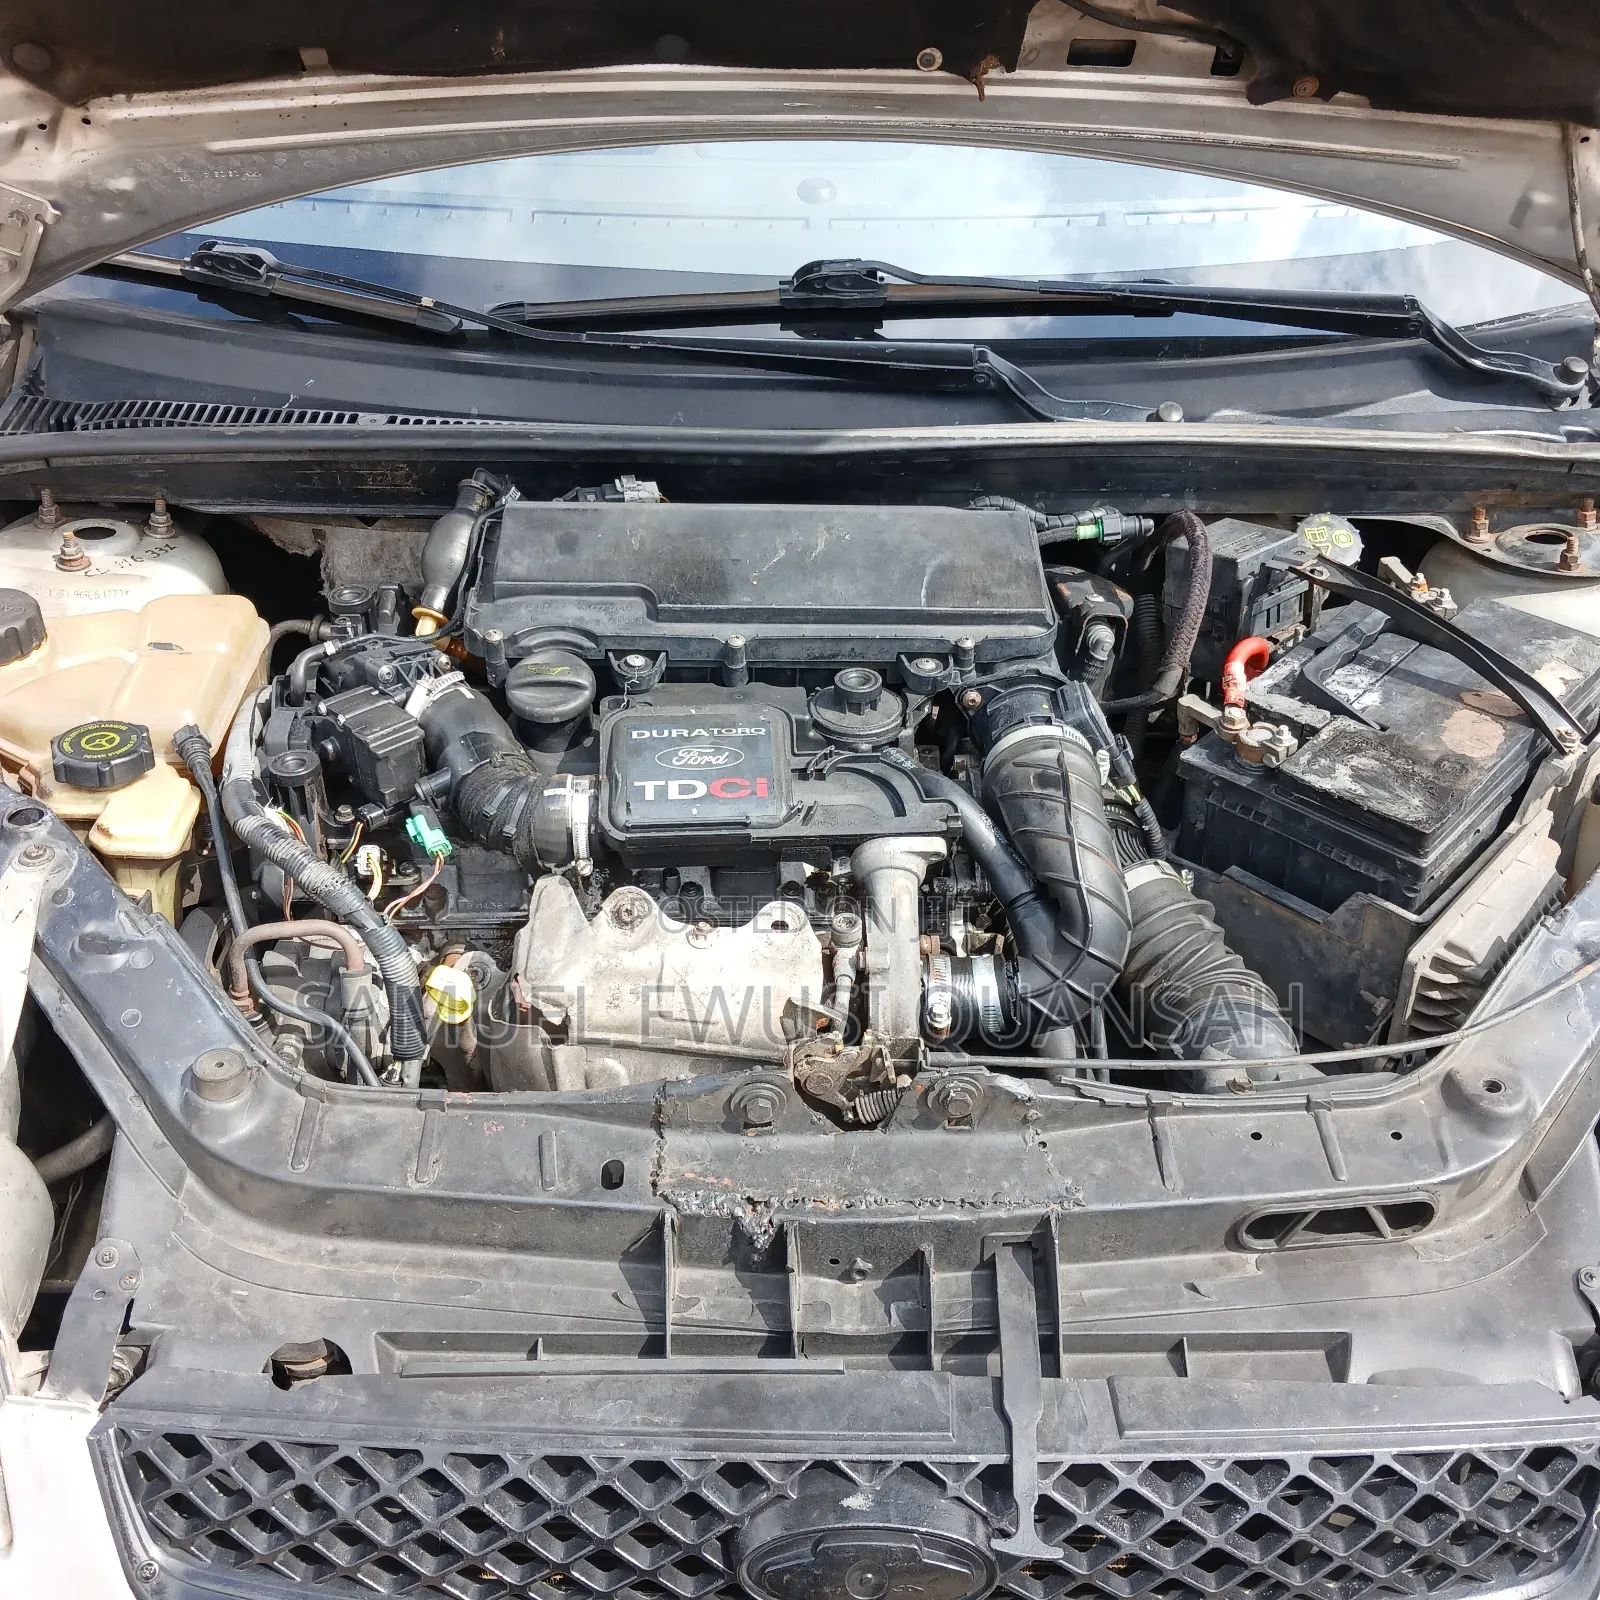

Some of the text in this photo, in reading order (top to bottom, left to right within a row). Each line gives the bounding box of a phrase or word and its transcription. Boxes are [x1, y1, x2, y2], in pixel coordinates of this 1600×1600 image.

[631, 728, 766, 739] DURATORQ
[672, 748, 729, 766] Ford
[633, 777, 768, 800] TDCi
